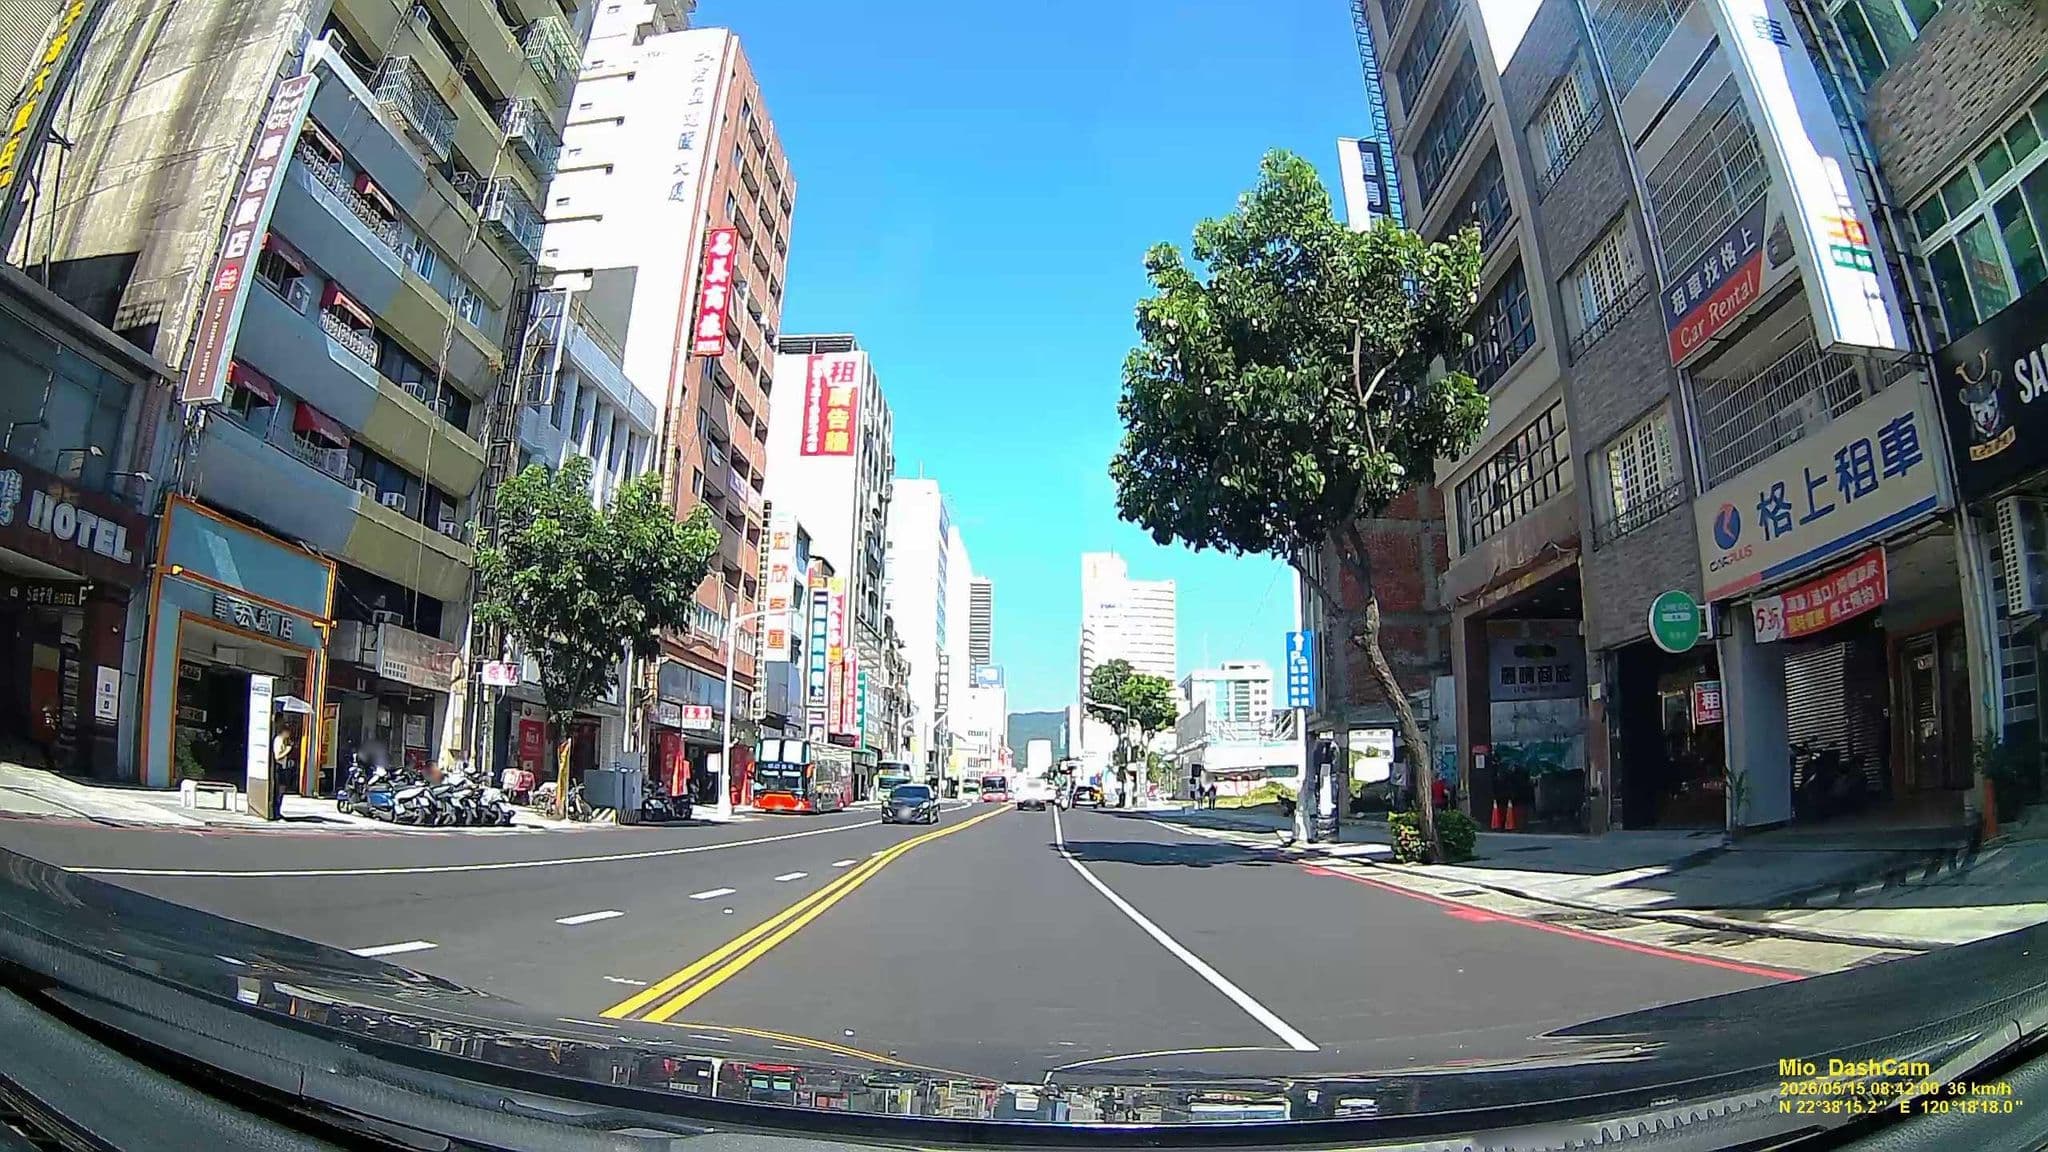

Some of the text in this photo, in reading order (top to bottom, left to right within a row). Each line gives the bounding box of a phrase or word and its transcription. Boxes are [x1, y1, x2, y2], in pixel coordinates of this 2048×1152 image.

[1671, 227, 1757, 317] 租車找格上
[1680, 271, 1754, 350] Car Rental
[829, 361, 856, 383] 租
[2014, 343, 2048, 405] SA
[1756, 411, 1923, 541] 格上租車
[28, 489, 133, 564] HOTEL
[1702, 691, 1720, 710] 租
